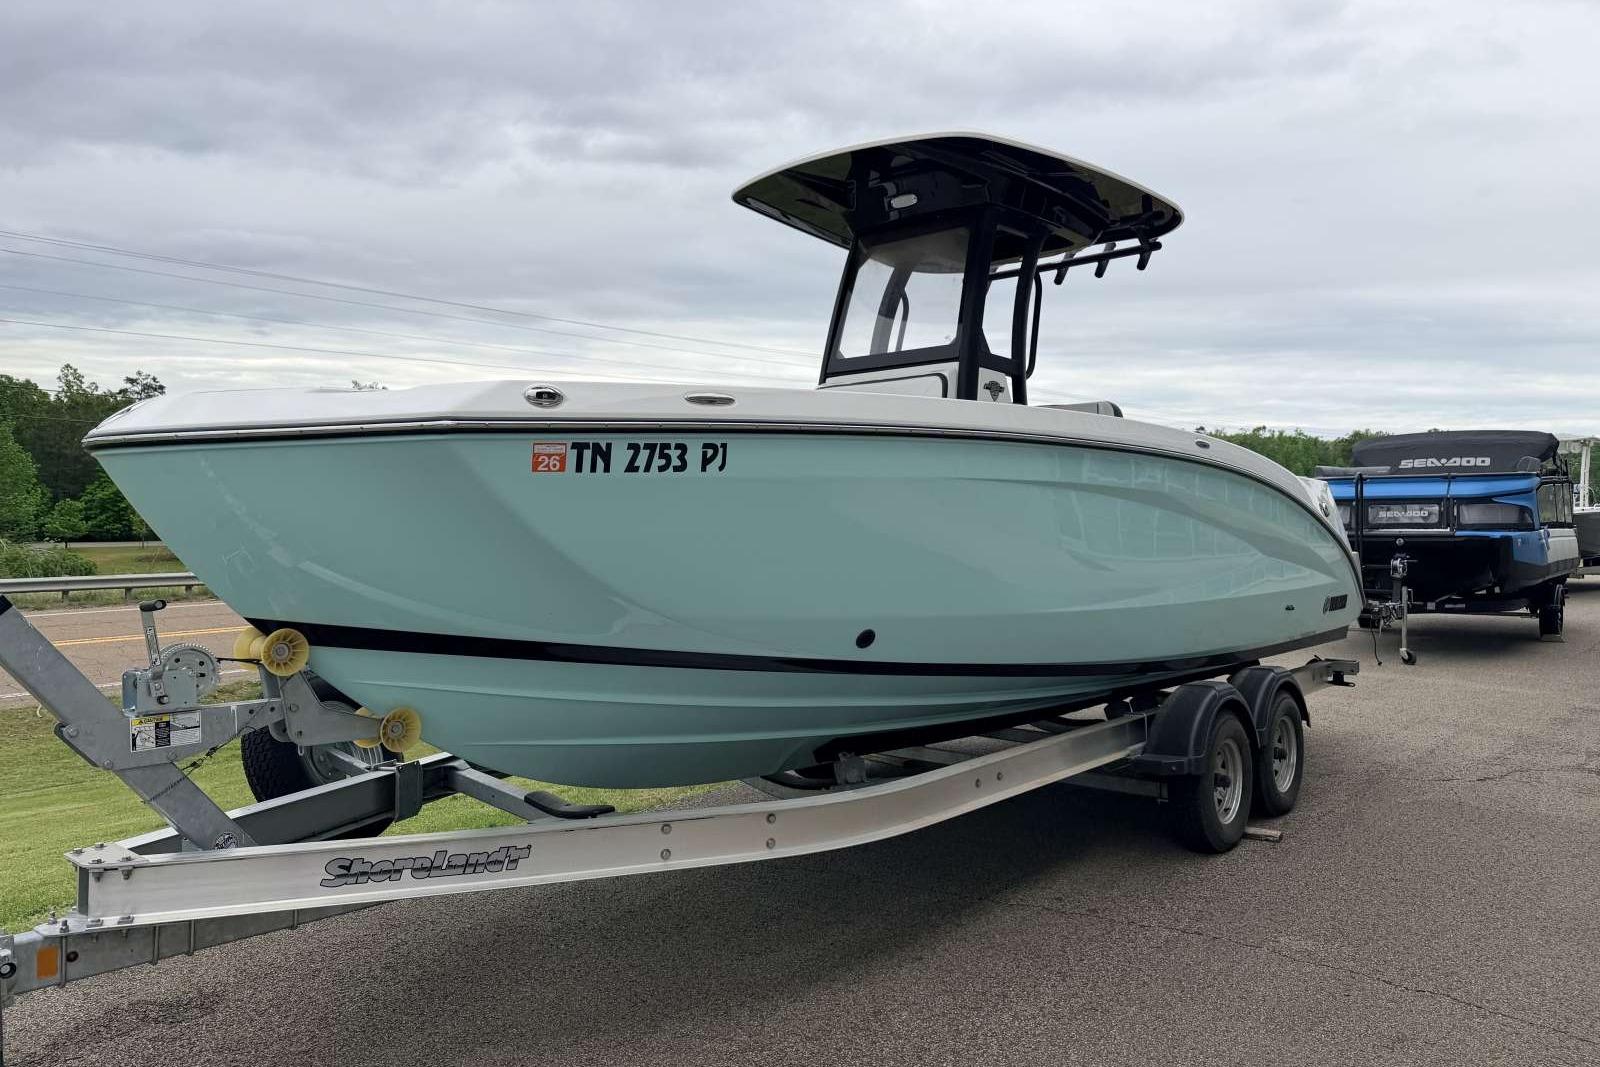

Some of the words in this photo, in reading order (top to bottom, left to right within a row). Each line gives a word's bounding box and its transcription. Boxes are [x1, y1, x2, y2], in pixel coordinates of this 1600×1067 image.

[537, 455, 560, 471] 26
[570, 442, 612, 473] TN
[624, 442, 688, 473] 2753
[700, 442, 728, 473] PJ
